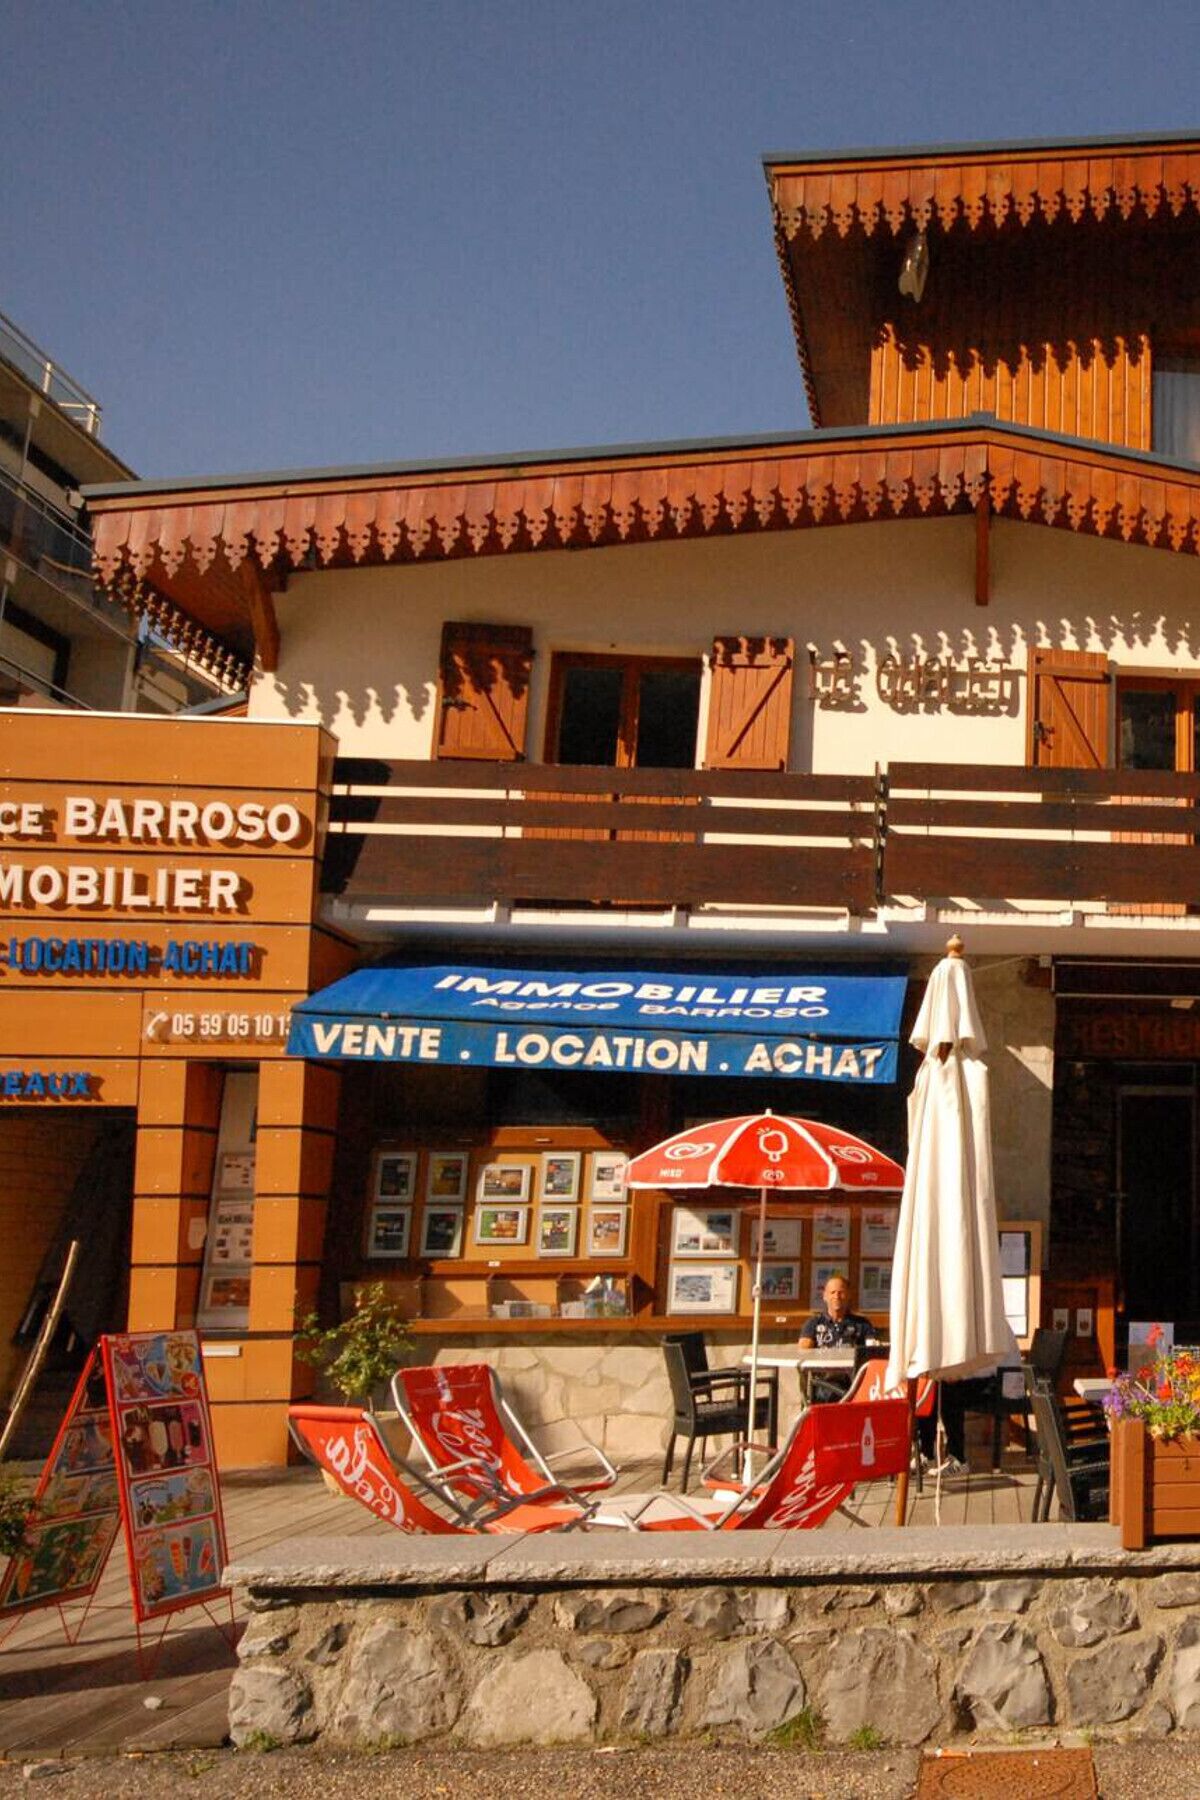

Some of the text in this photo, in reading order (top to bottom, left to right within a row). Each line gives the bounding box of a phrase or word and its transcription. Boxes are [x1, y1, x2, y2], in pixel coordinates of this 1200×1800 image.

[0, 796, 300, 842] CE BARROSO
[0, 864, 240, 909] MOBILIER
[434, 975, 826, 1004] IMMOBILIER
[471, 997, 830, 1019] Agence BARROSO
[172, 1013, 195, 1036] 05
[200, 1013, 222, 1036] 59
[227, 1013, 249, 1037] 05
[255, 1014, 274, 1037] 10
[312, 1023, 442, 1059] VENTE
[496, 1032, 709, 1071] LOCATION
[744, 1042, 883, 1079] ACHAT
[0, 1071, 91, 1096] EAUX
